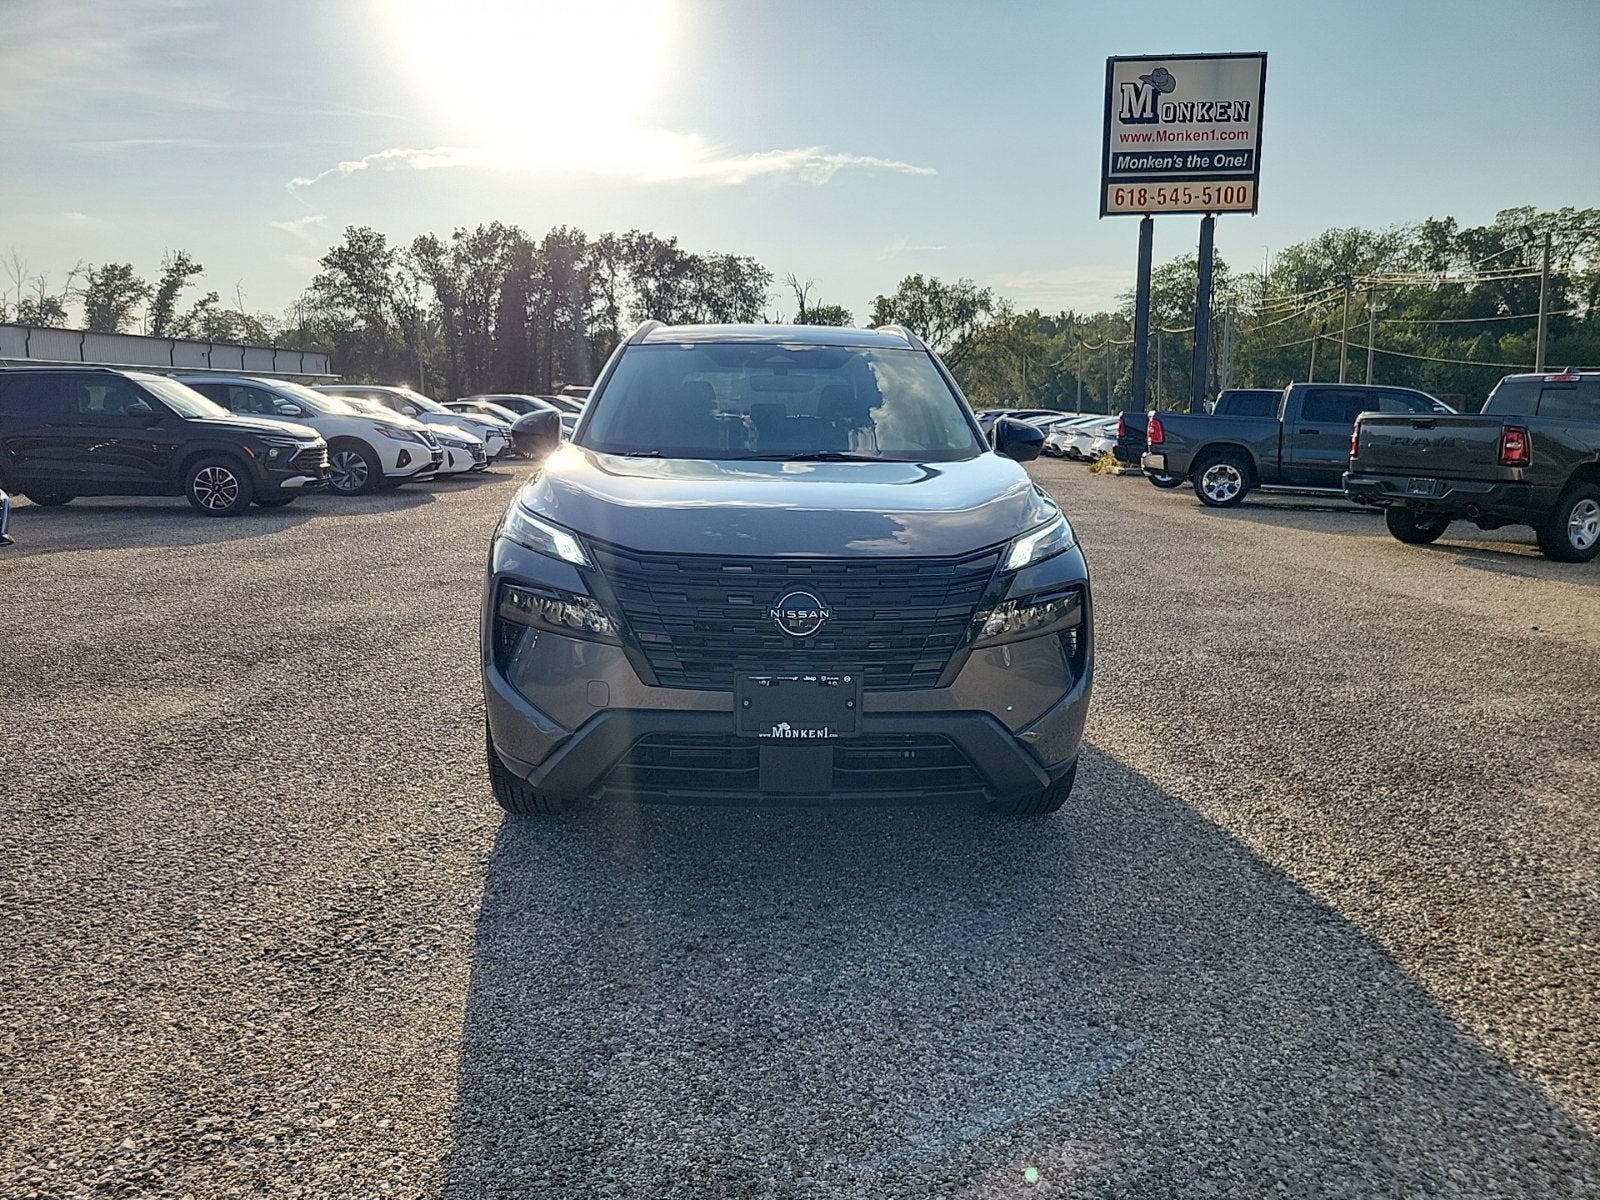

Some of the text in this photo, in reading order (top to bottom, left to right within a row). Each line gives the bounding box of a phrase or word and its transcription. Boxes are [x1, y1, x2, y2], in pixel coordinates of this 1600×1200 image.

[1119, 129, 1248, 143] www.Monken1.com
[1116, 153, 1248, 169] Monken's the One!
[1115, 186, 1247, 206] 618-545-5100
[770, 609, 829, 618] NISSAN
